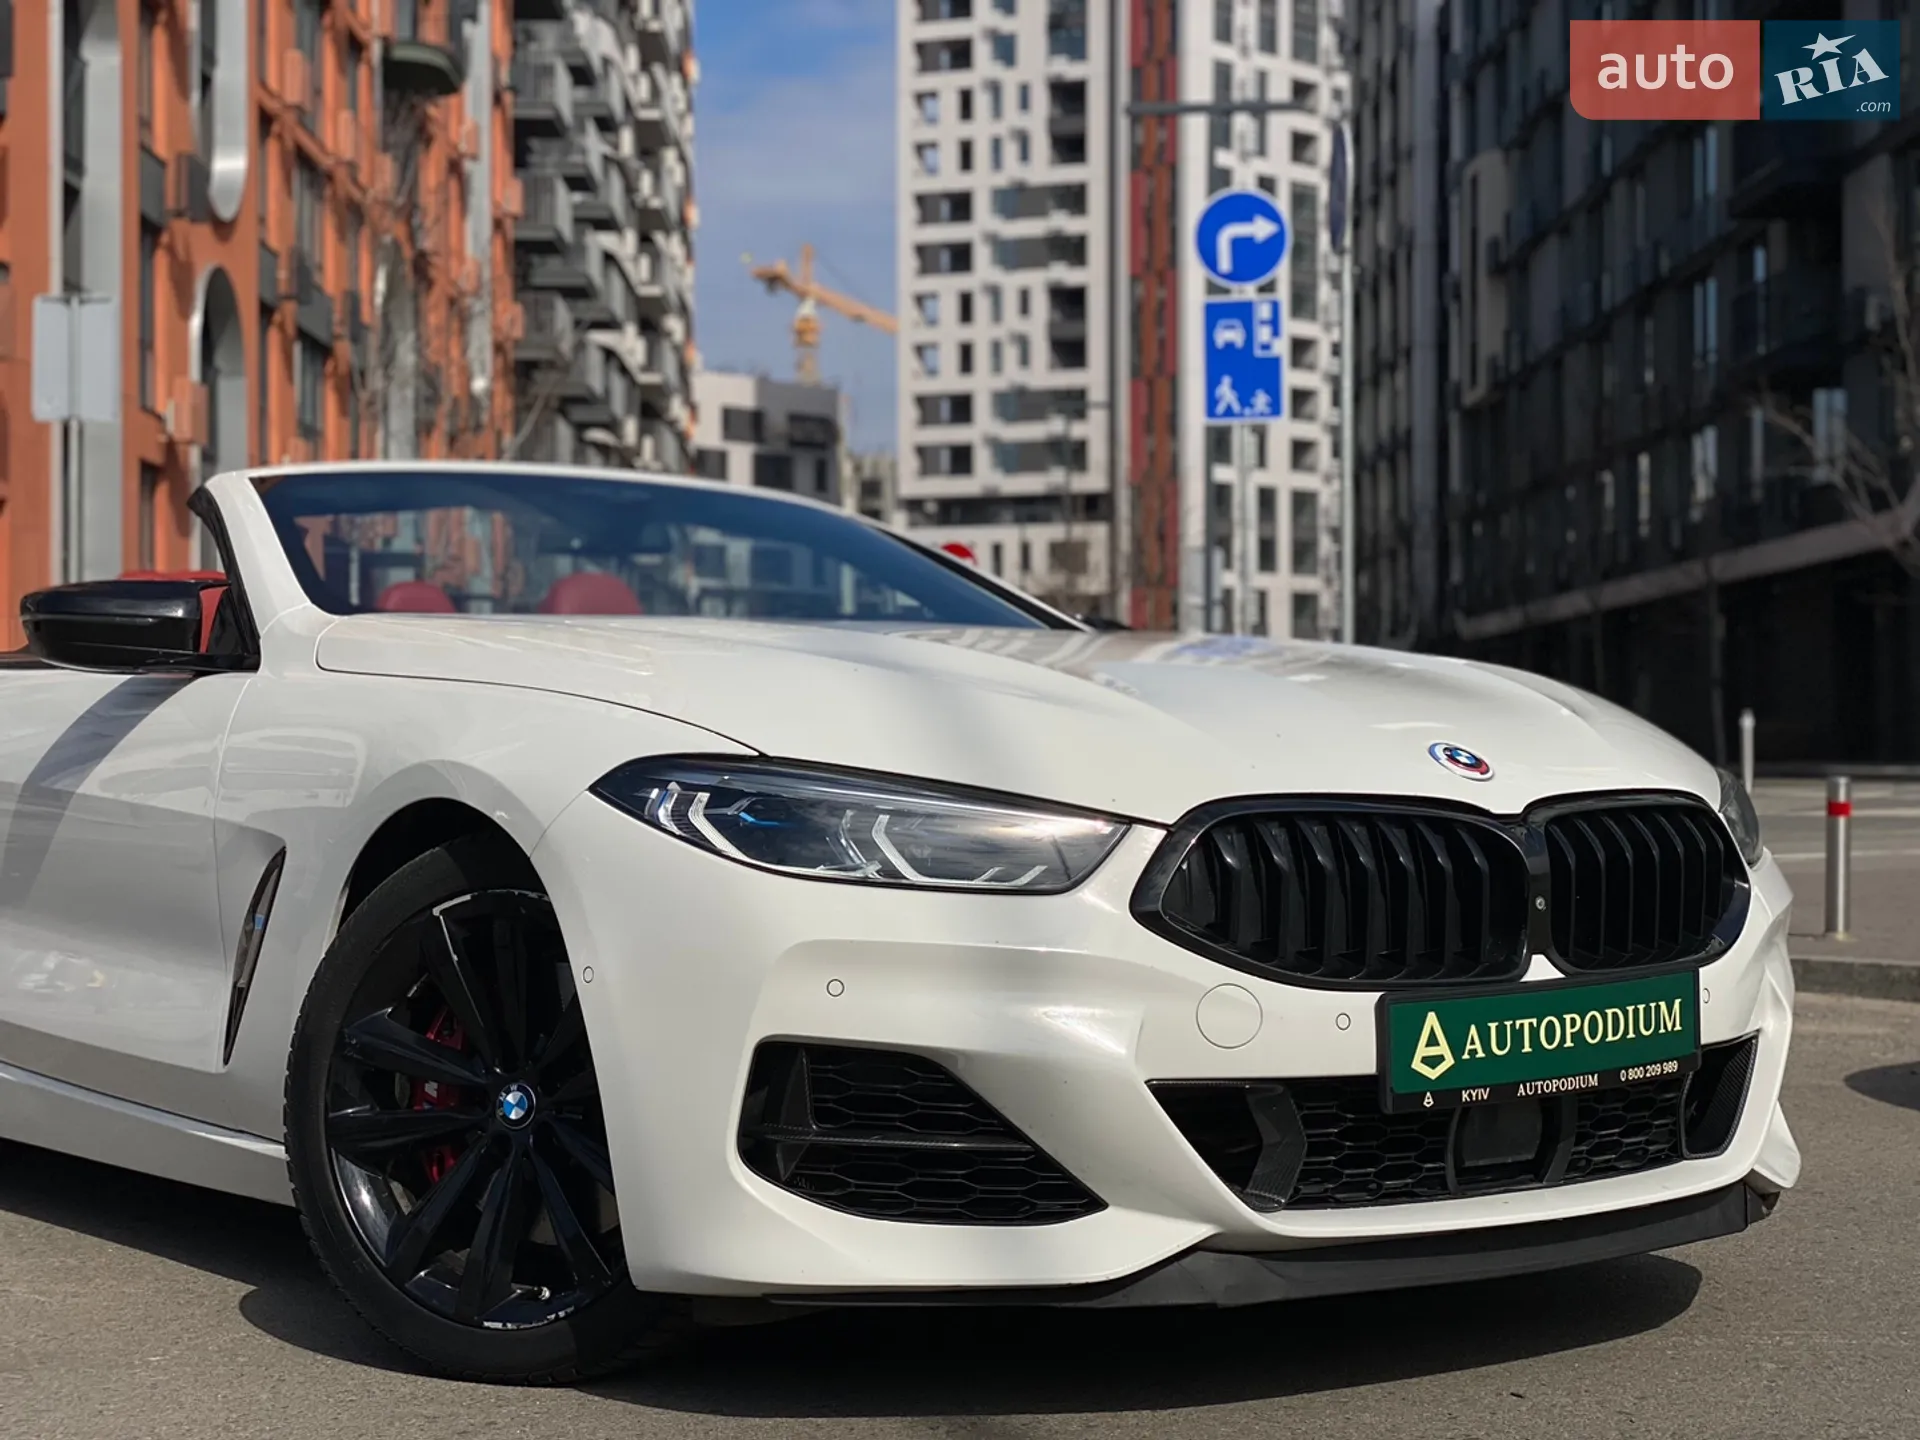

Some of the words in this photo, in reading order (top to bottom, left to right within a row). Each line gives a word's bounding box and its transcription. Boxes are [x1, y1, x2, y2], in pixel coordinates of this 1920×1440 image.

[1461, 998, 1682, 1060] AUTOPODIUM
[1461, 1087, 1490, 1102] KYIV
[1517, 1073, 1599, 1097] AUTOPODIUM
[1619, 1069, 1627, 1082] 0
[1627, 1066, 1644, 1080] 800
[1645, 1063, 1662, 1078] 209
[1662, 1060, 1679, 1074] 989
